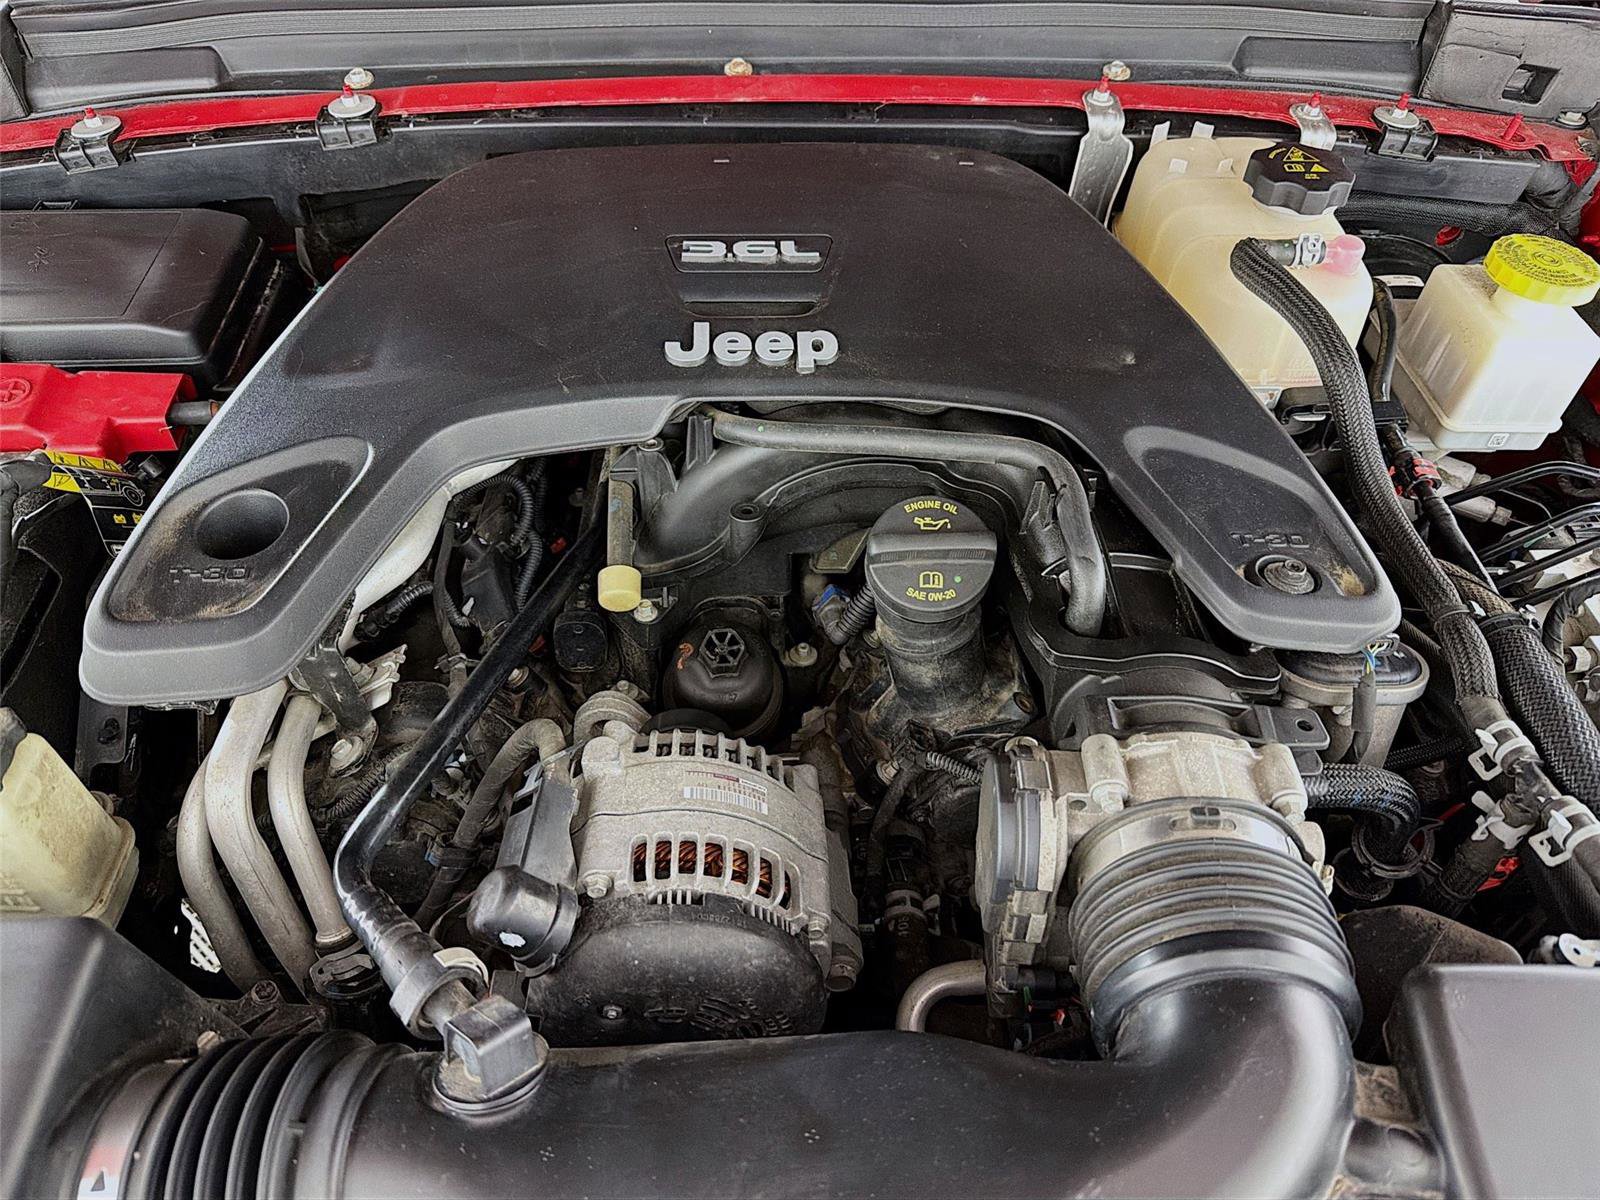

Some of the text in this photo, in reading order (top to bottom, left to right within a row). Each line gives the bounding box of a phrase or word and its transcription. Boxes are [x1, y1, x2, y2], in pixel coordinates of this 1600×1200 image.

[681, 240, 822, 263] 3.6L
[664, 321, 839, 374] Jeep
[904, 501, 958, 515] ENGINE OIL
[906, 587, 956, 601] SAE 0W-20
